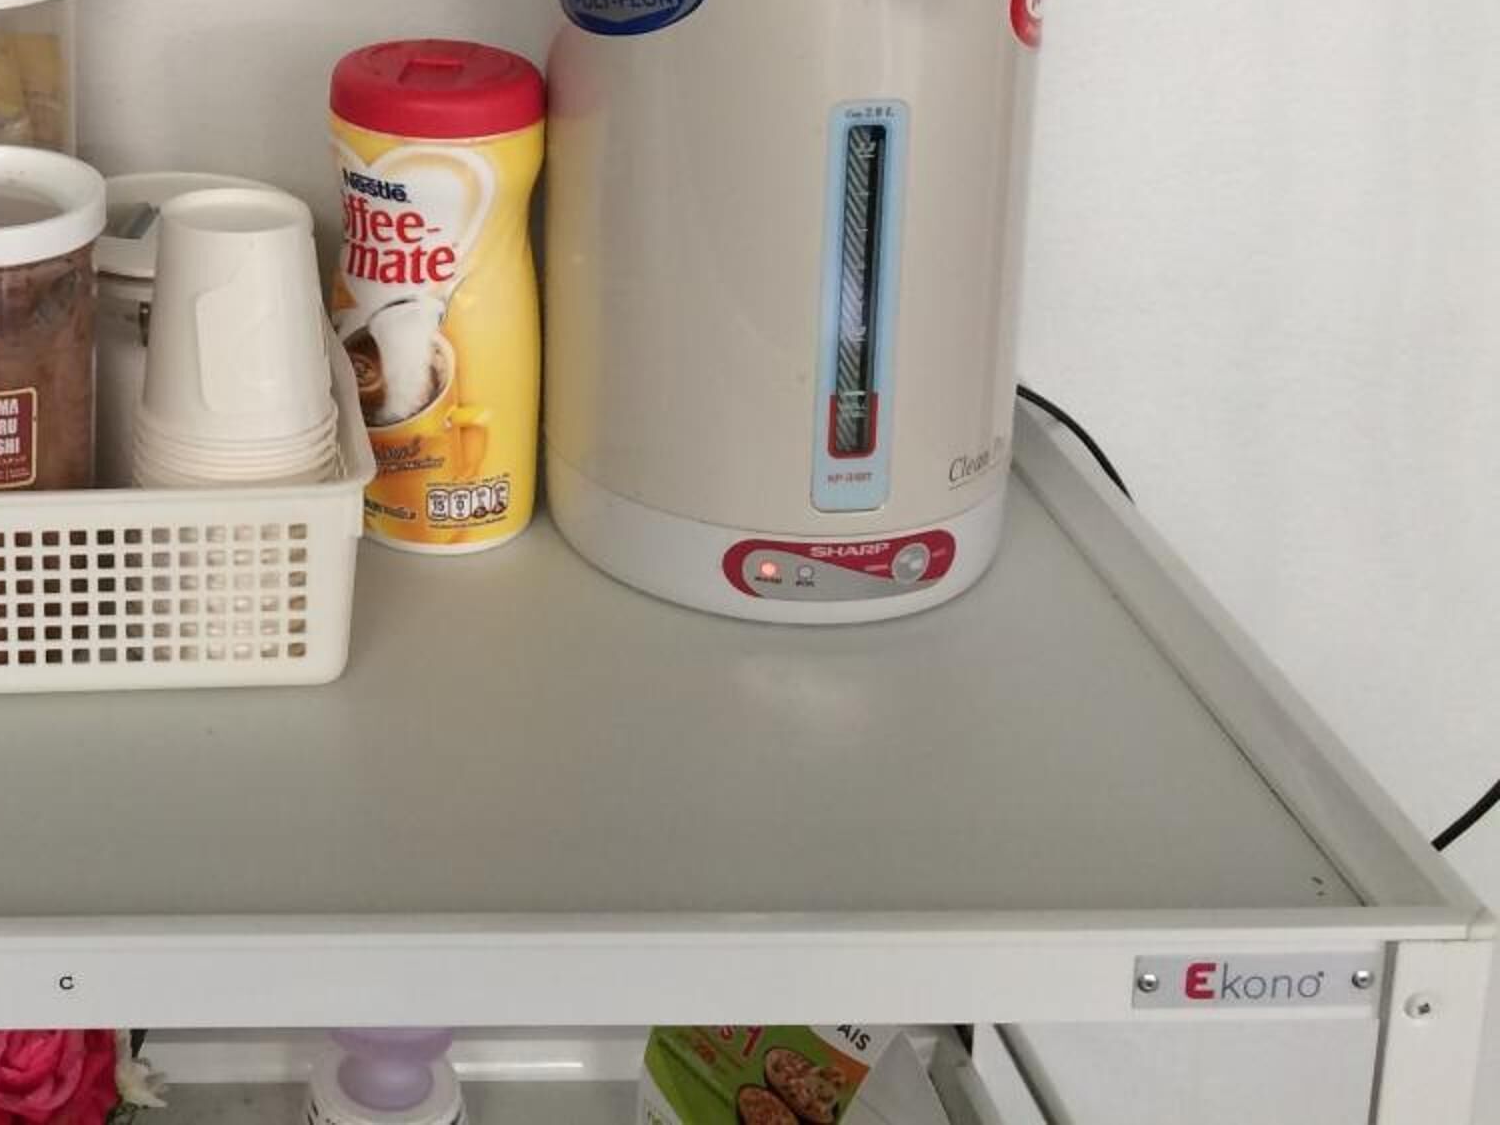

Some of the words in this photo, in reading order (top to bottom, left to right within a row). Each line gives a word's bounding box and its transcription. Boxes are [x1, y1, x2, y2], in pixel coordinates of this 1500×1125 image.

[346, 241, 455, 284] mate
[809, 542, 891, 557] SHARP
[1185, 961, 1322, 1000] Ekono
